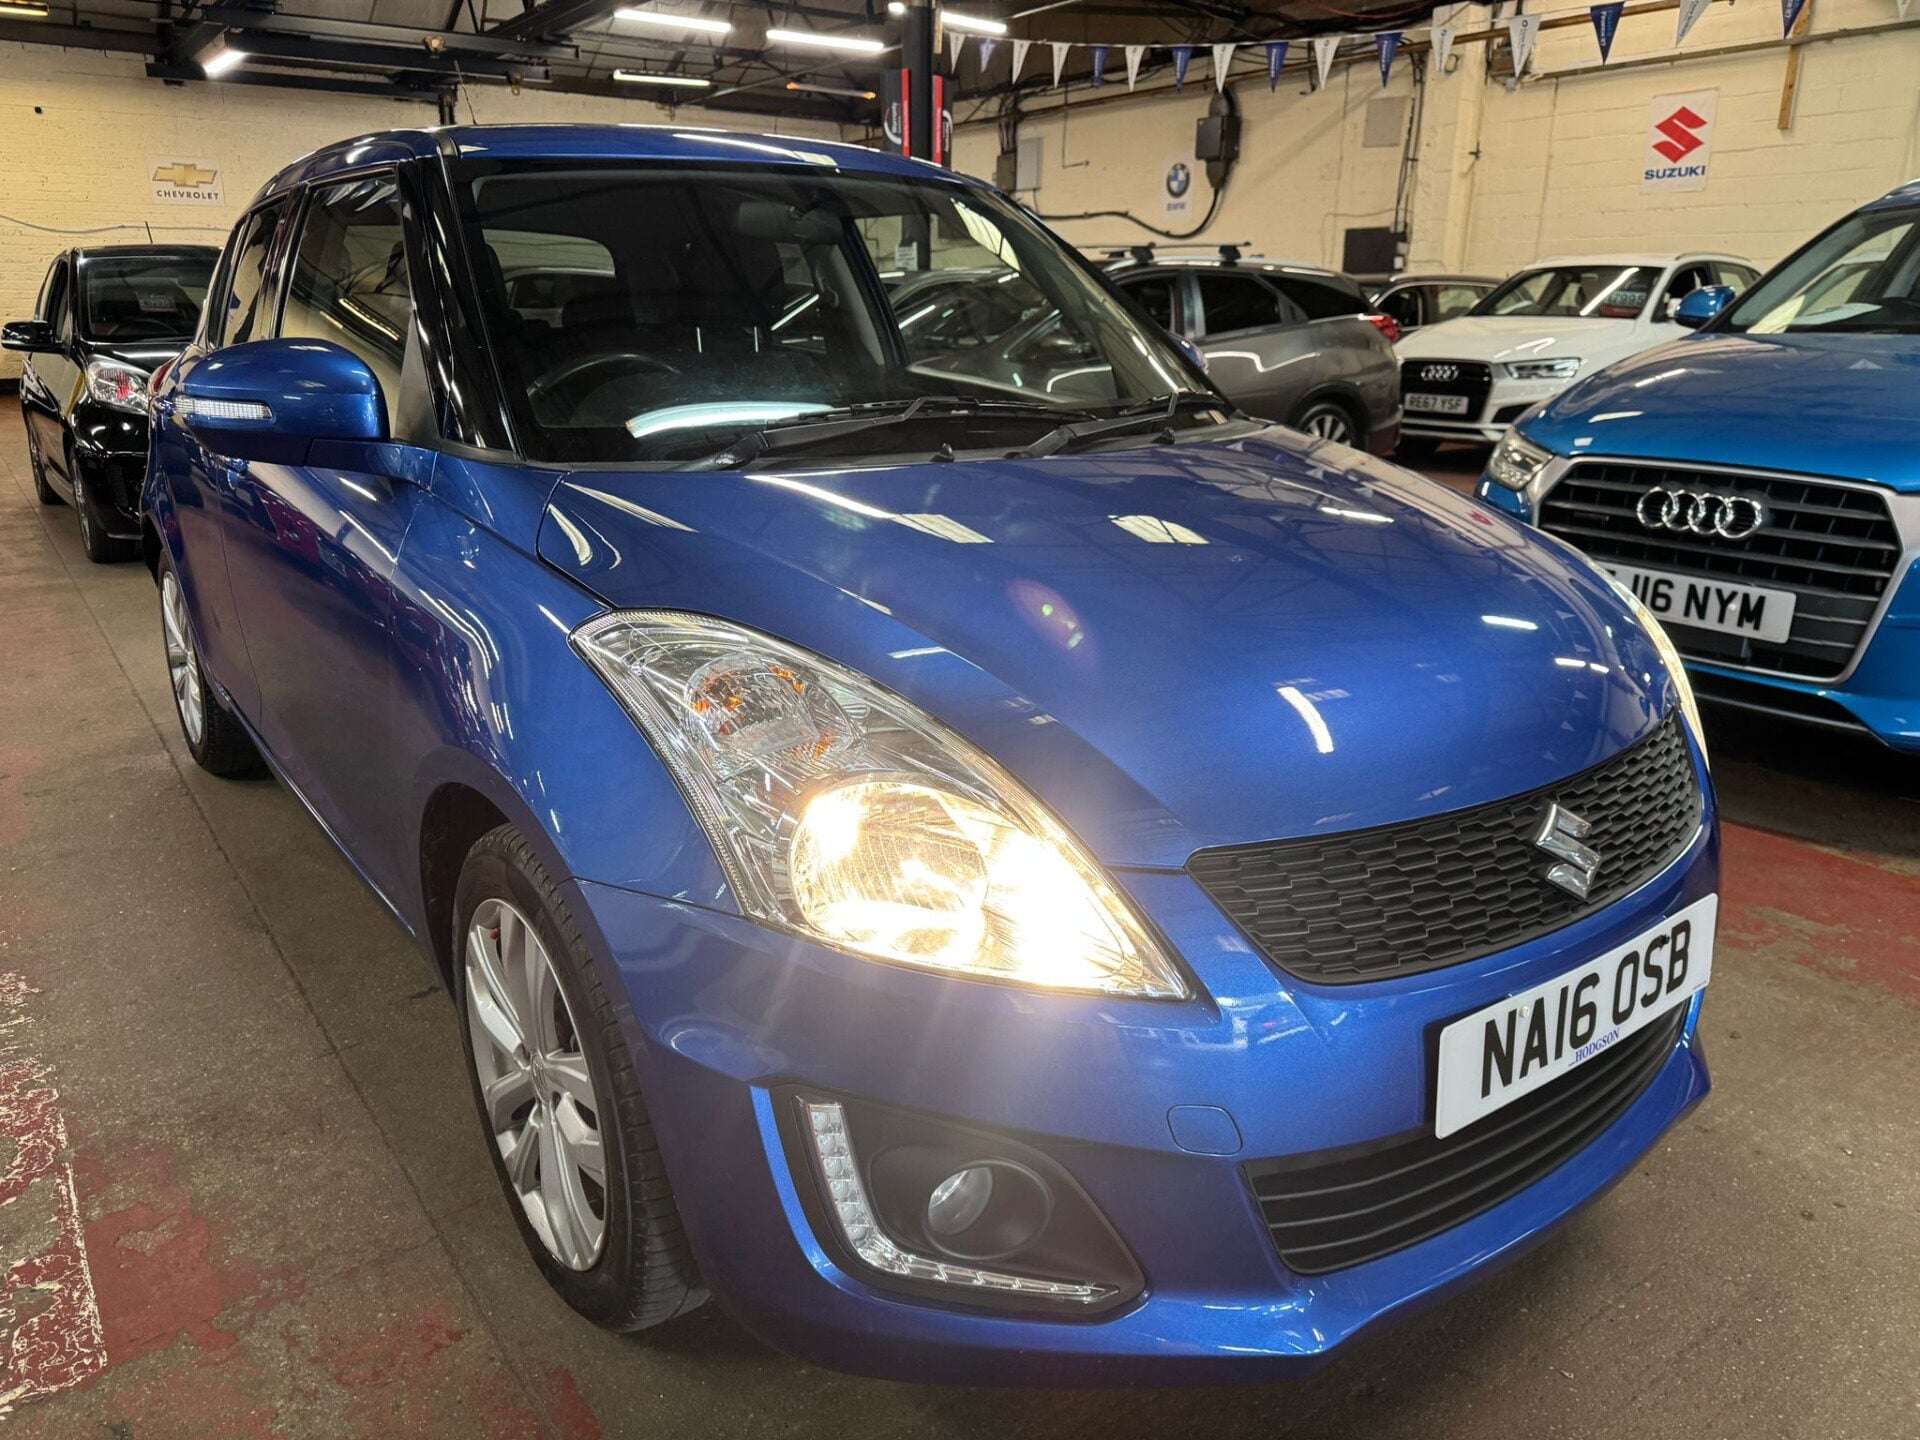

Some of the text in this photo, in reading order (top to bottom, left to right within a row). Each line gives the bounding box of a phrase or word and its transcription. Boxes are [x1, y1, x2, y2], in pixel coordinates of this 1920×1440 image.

[1644, 165, 1706, 180] SUZUKI
[156, 190, 219, 200] CHEVROLET
[1605, 570, 1766, 631] 16 NYM
[1481, 919, 1691, 1099] NA16 OSB
[1575, 1028, 1620, 1063] HODGSON
